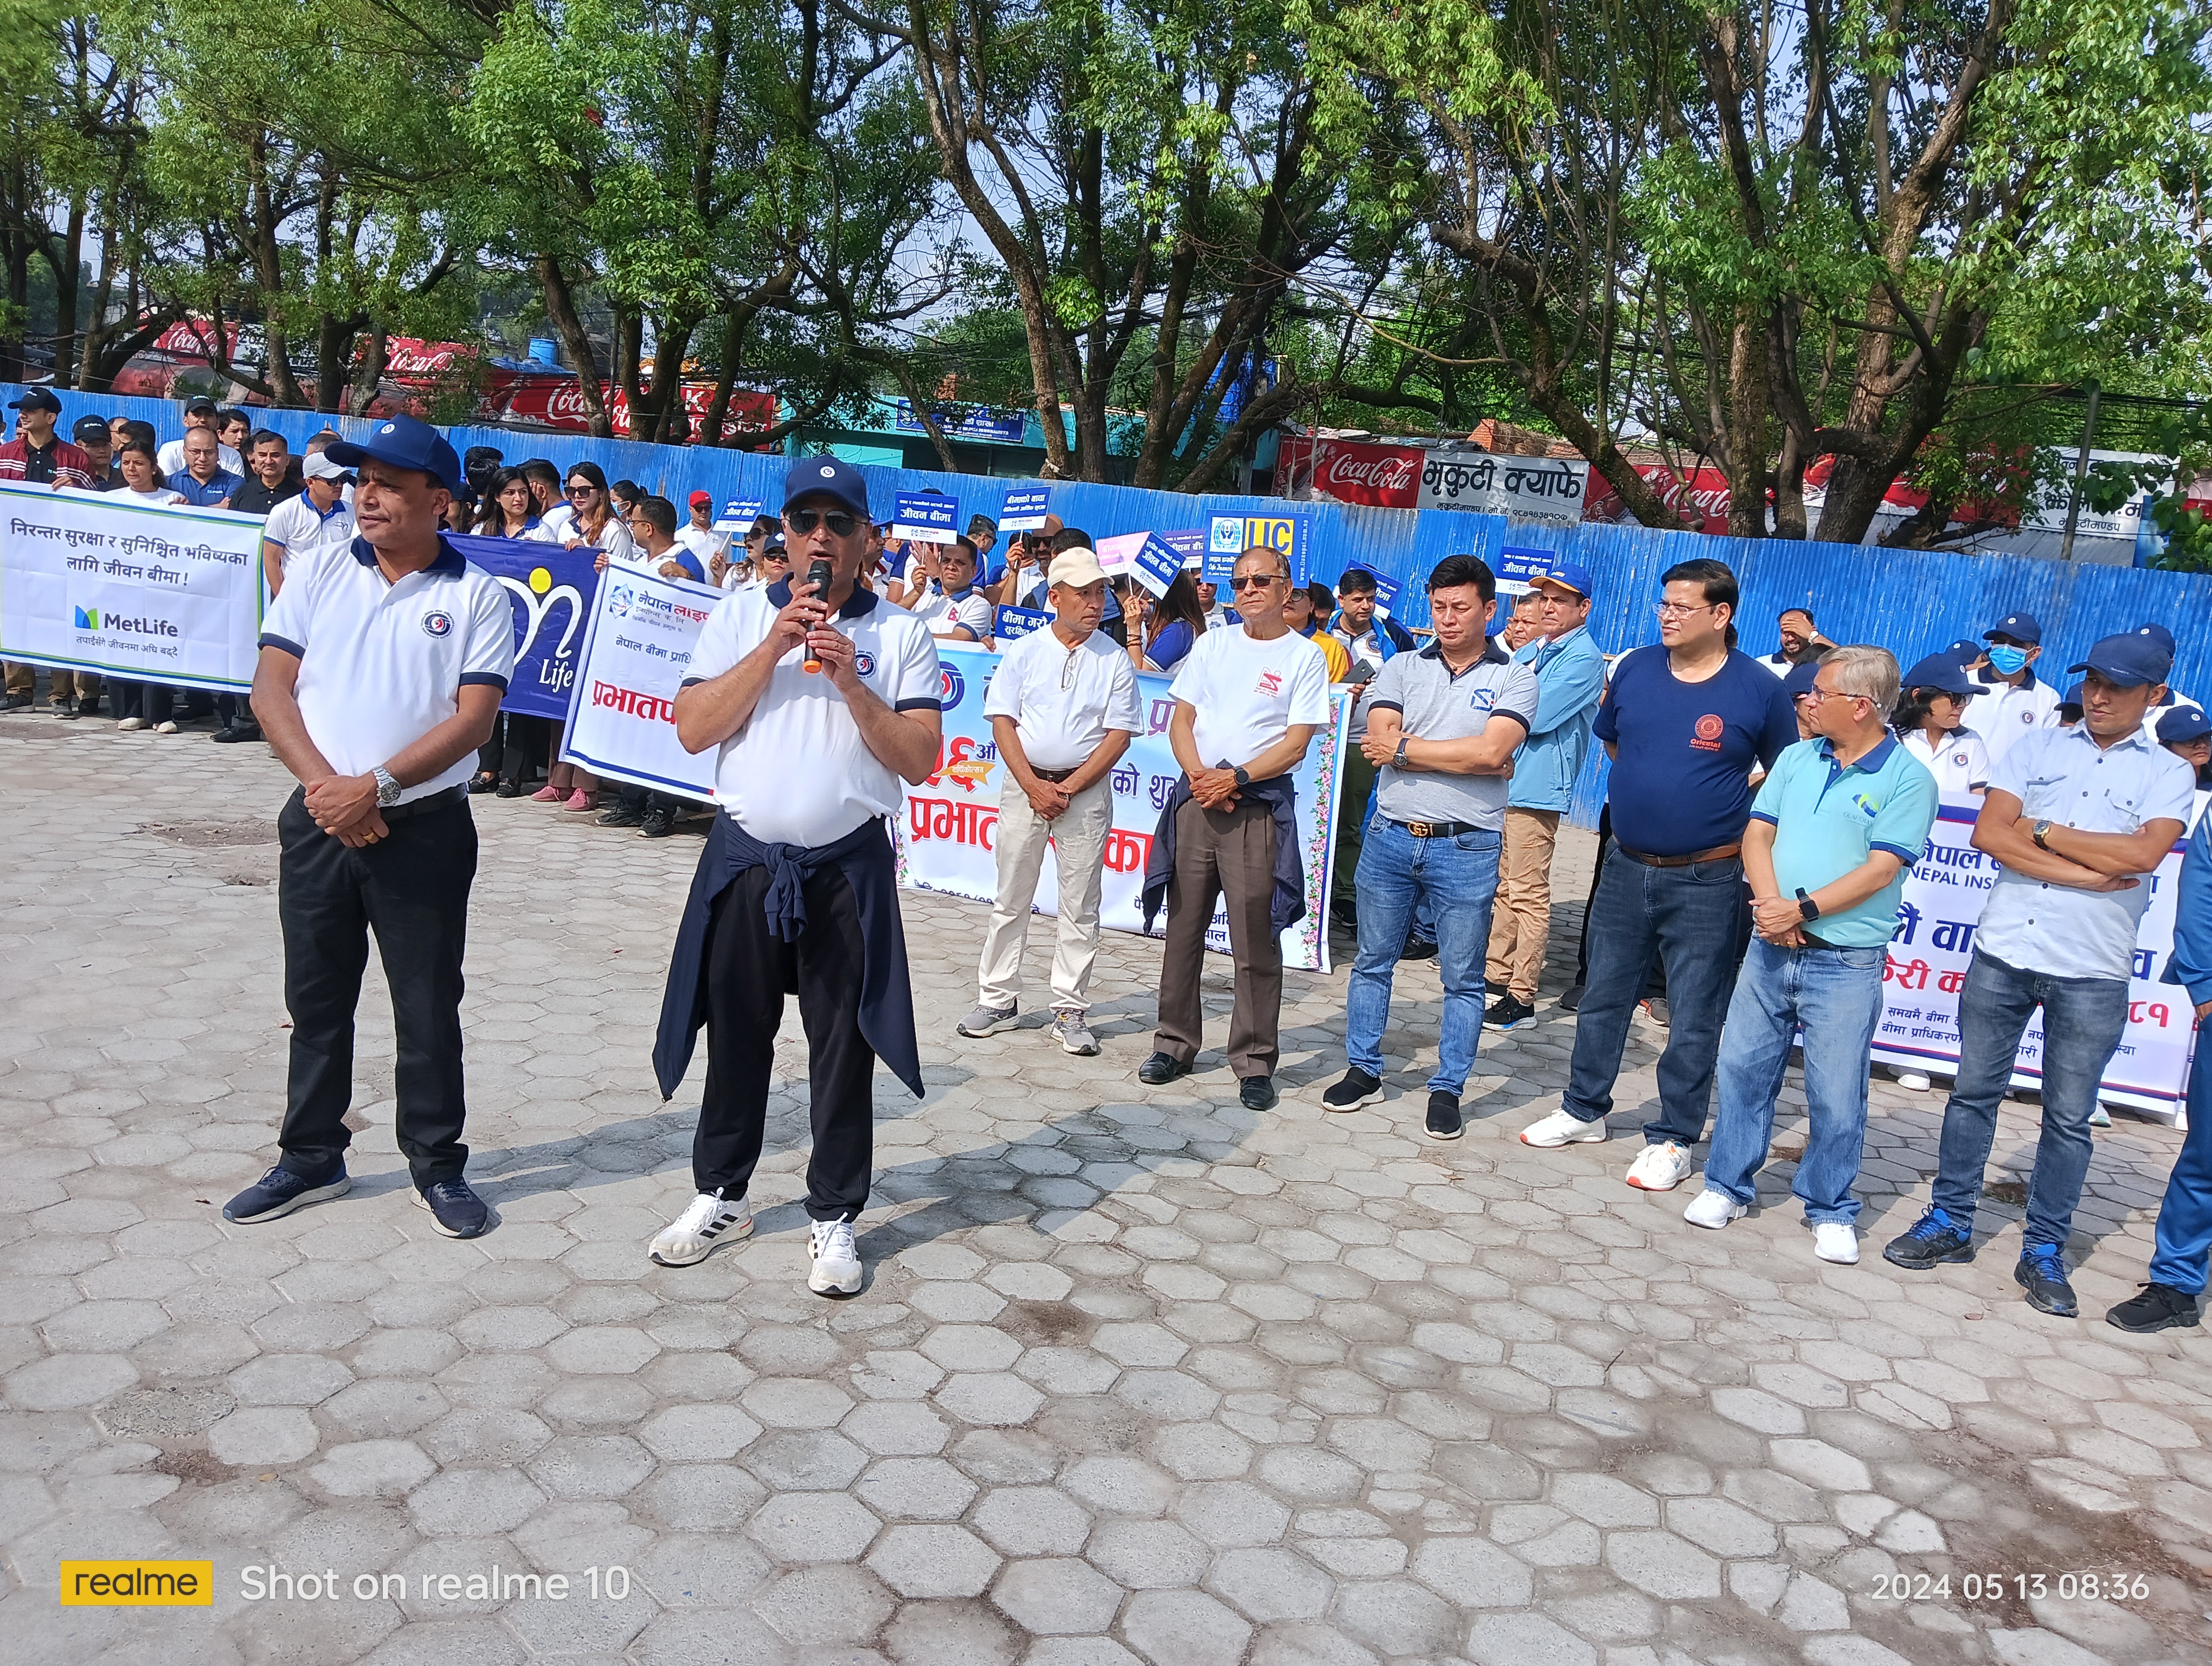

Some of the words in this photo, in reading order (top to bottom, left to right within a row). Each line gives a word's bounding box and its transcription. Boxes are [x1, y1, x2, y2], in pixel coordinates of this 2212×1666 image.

[1329, 453, 1414, 490] Coca-Cola
[1422, 458, 1497, 497] भृकुटी
[1504, 460, 1585, 498] क्याफे
[901, 508, 928, 520] जीवन
[930, 510, 952, 522] बीमा
[10, 518, 61, 540] निरन्तर
[65, 529, 105, 548] सुरक्षा
[108, 536, 117, 548] र
[120, 535, 180, 559] सुनिश्चित
[184, 544, 248, 566] भविष्यका
[1248, 521, 1290, 552] LIC
[67, 555, 100, 573] लागि
[103, 560, 143, 579] जीवन
[147, 565, 181, 585] बीमा
[1142, 550, 1160, 568] जीवन
[1502, 562, 1527, 574] जीवन
[1528, 565, 1548, 576] बीमा
[638, 591, 672, 613] नेपाल
[104, 613, 178, 637] MetLife
[1002, 610, 1026, 626] बीमा
[108, 639, 139, 651] जीवनमा
[141, 643, 158, 654] अघि
[616, 635, 642, 651] नेपाल
[646, 643, 668, 658] बीमा
[538, 658, 574, 693] Life
[1147, 699, 1177, 736] प्र
[1690, 738, 1721, 748] Oriental
[951, 764, 984, 774] वार्षिकोत्सव
[1109, 762, 1141, 797] को
[908, 796, 999, 851] प्रभात
[1103, 828, 1156, 874] का
[1910, 866, 1959, 885] NEPAL
[1964, 874, 1993, 890] INS
[1932, 919, 1979, 953] वा
[2132, 948, 2158, 981] व
[1938, 970, 1966, 994] क
[2129, 1001, 2169, 1028] ८१
[1888, 1006, 1922, 1021] समयमै
[1926, 1008, 1951, 1024] बीमा
[1882, 1022, 1907, 1036] बीमा
[2117, 1044, 2136, 1056] स्या
